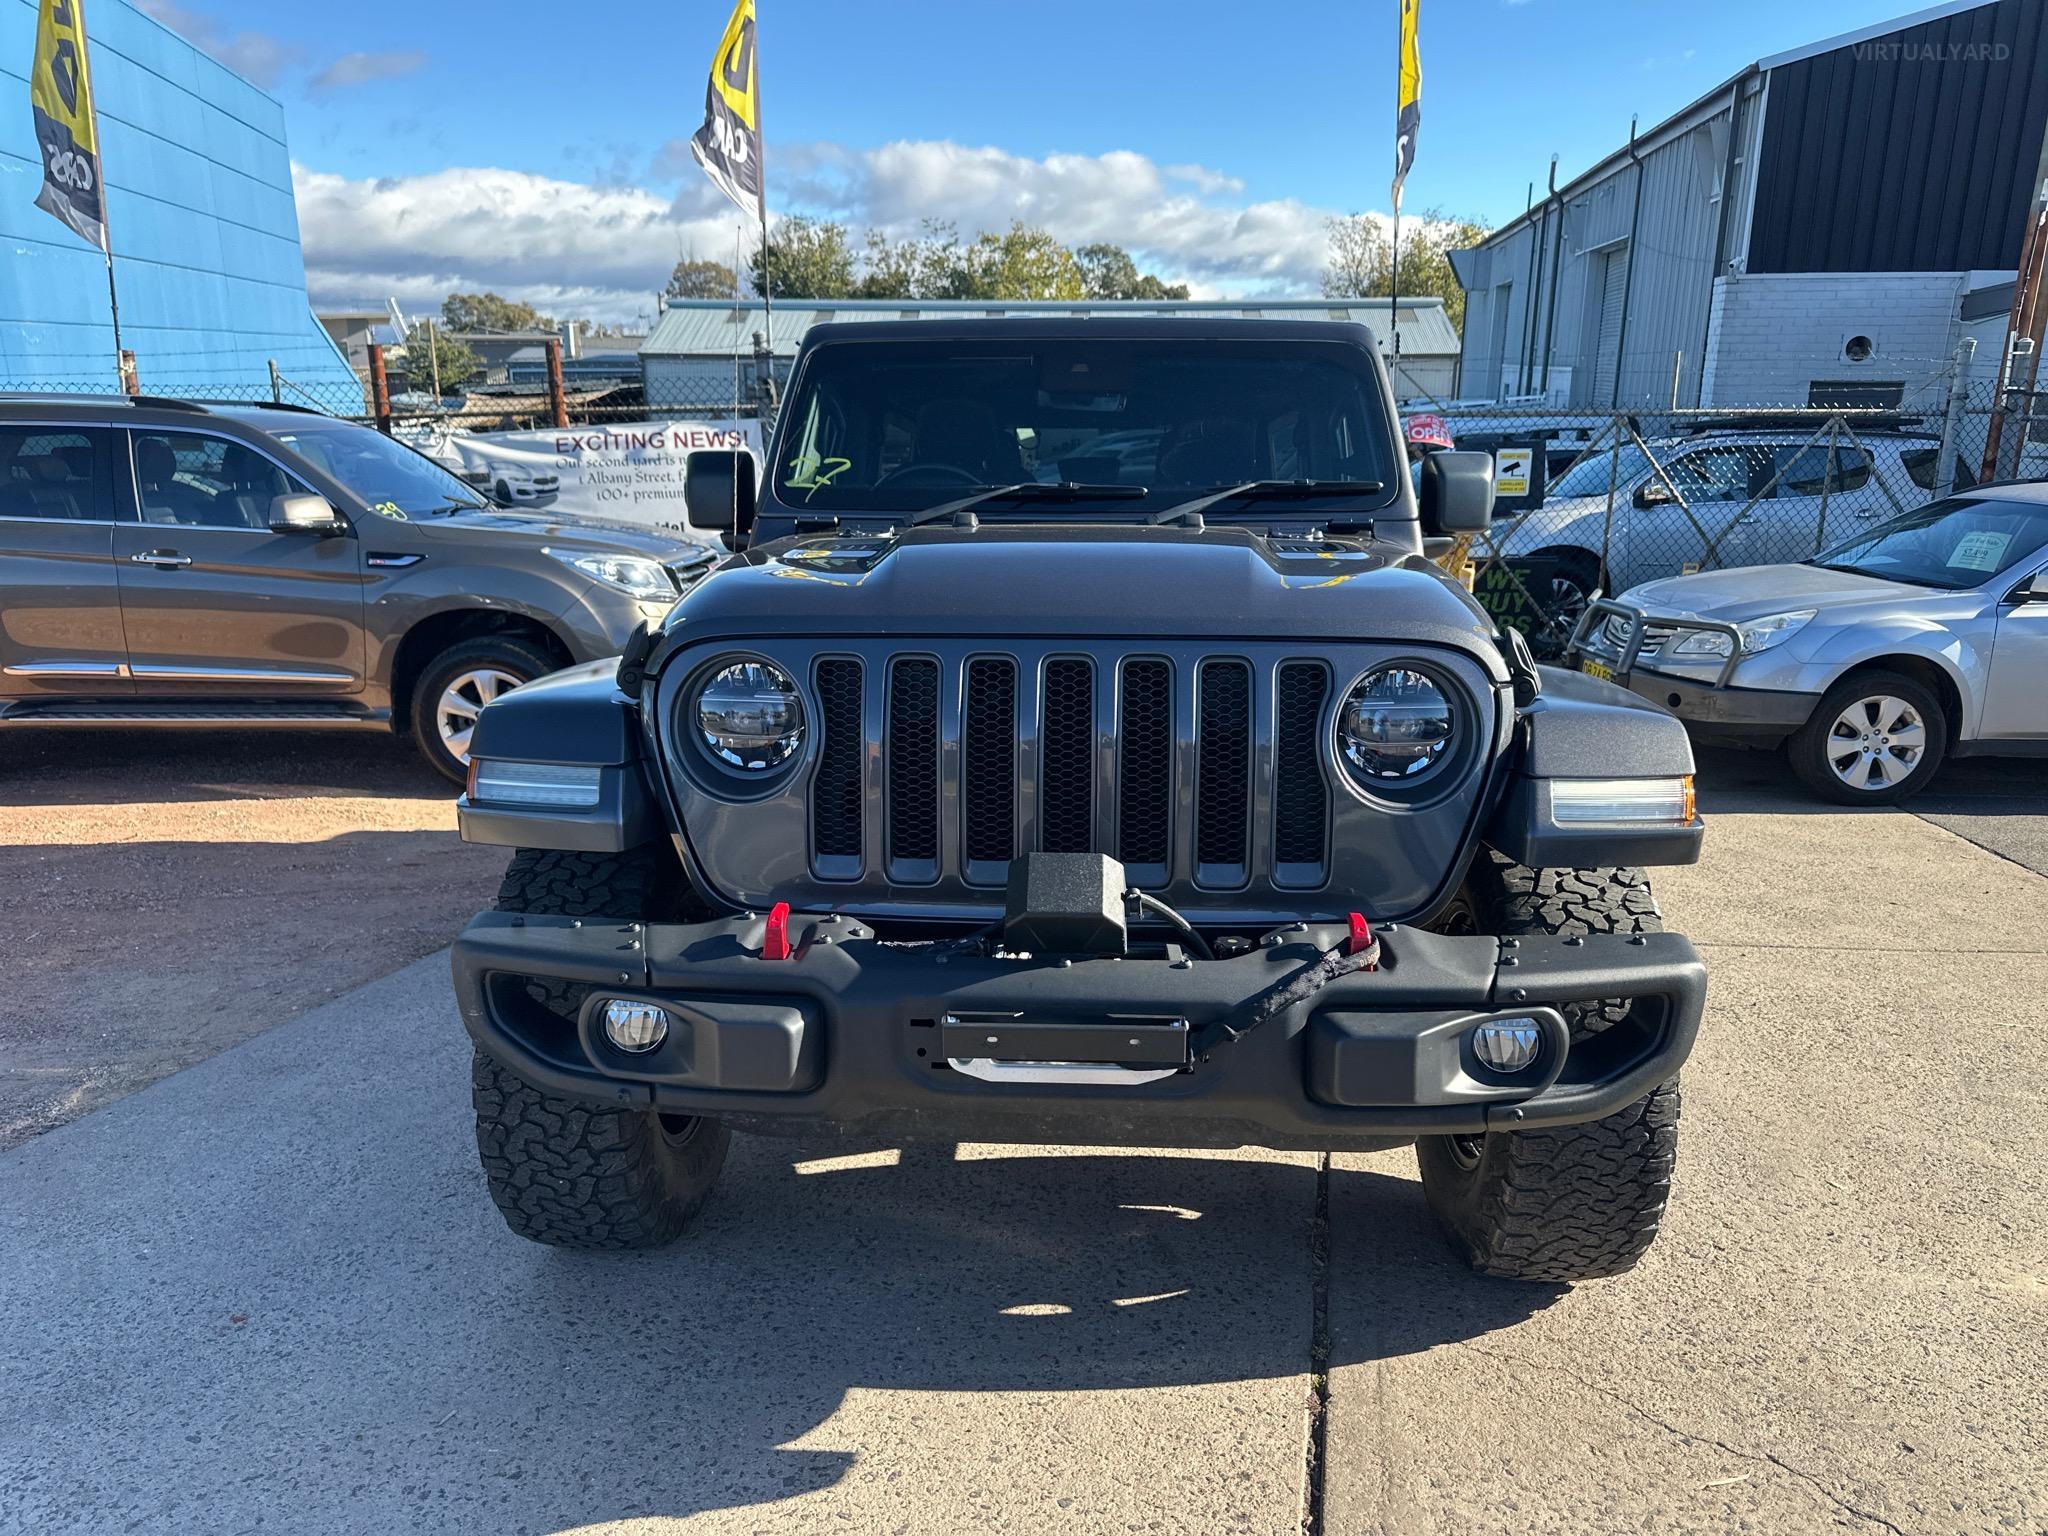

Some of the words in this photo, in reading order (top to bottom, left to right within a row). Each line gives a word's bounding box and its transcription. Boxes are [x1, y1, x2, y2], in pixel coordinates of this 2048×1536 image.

[556, 432, 665, 453] EXCITING
[673, 430, 749, 448] NEWS!
[1411, 427, 1451, 444] OPEN
[586, 454, 629, 468] second
[633, 453, 661, 470] yard
[587, 472, 632, 487] Albany
[597, 488, 629, 500] 100+
[1487, 569, 1531, 589] WE
